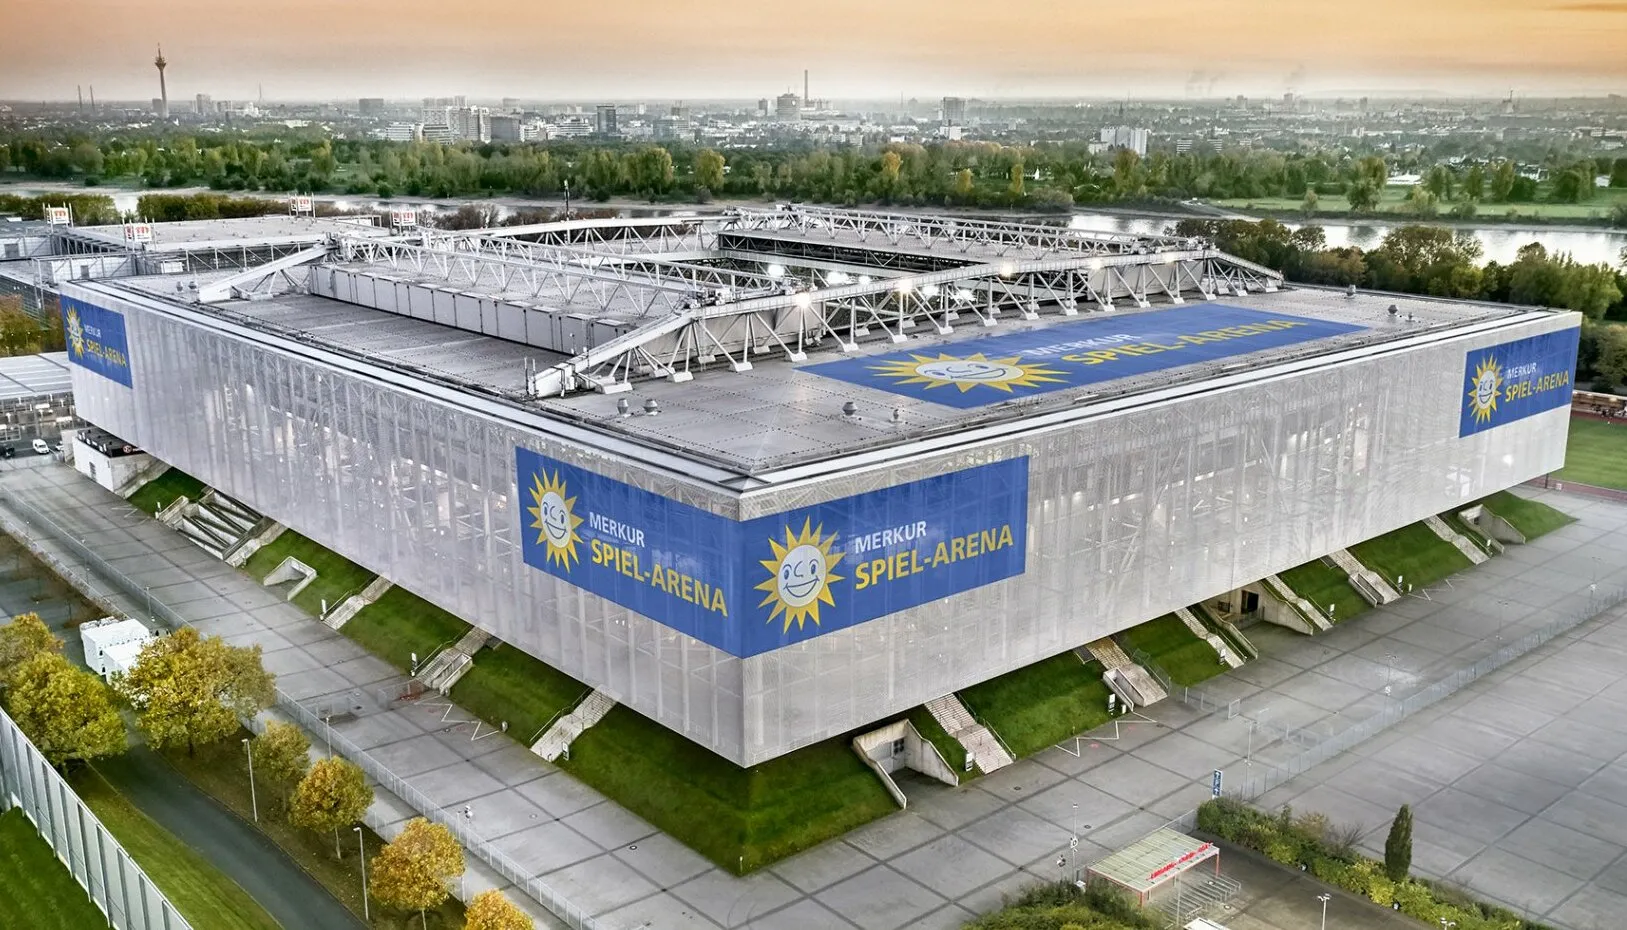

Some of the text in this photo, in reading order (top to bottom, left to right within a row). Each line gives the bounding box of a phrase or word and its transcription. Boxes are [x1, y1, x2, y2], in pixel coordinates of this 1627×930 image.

[1025, 333, 1142, 356] MERKUR
[1061, 319, 1309, 365] SPIEL-ARENA
[1504, 370, 1569, 403] SPIEL-ARENA
[1507, 362, 1537, 380] MERKUR
[589, 512, 646, 548] MERKUR
[854, 520, 927, 555] MERKUR
[854, 524, 1014, 591] SPIEL-ARENA
[590, 537, 728, 617] SPIEL-ARENA
